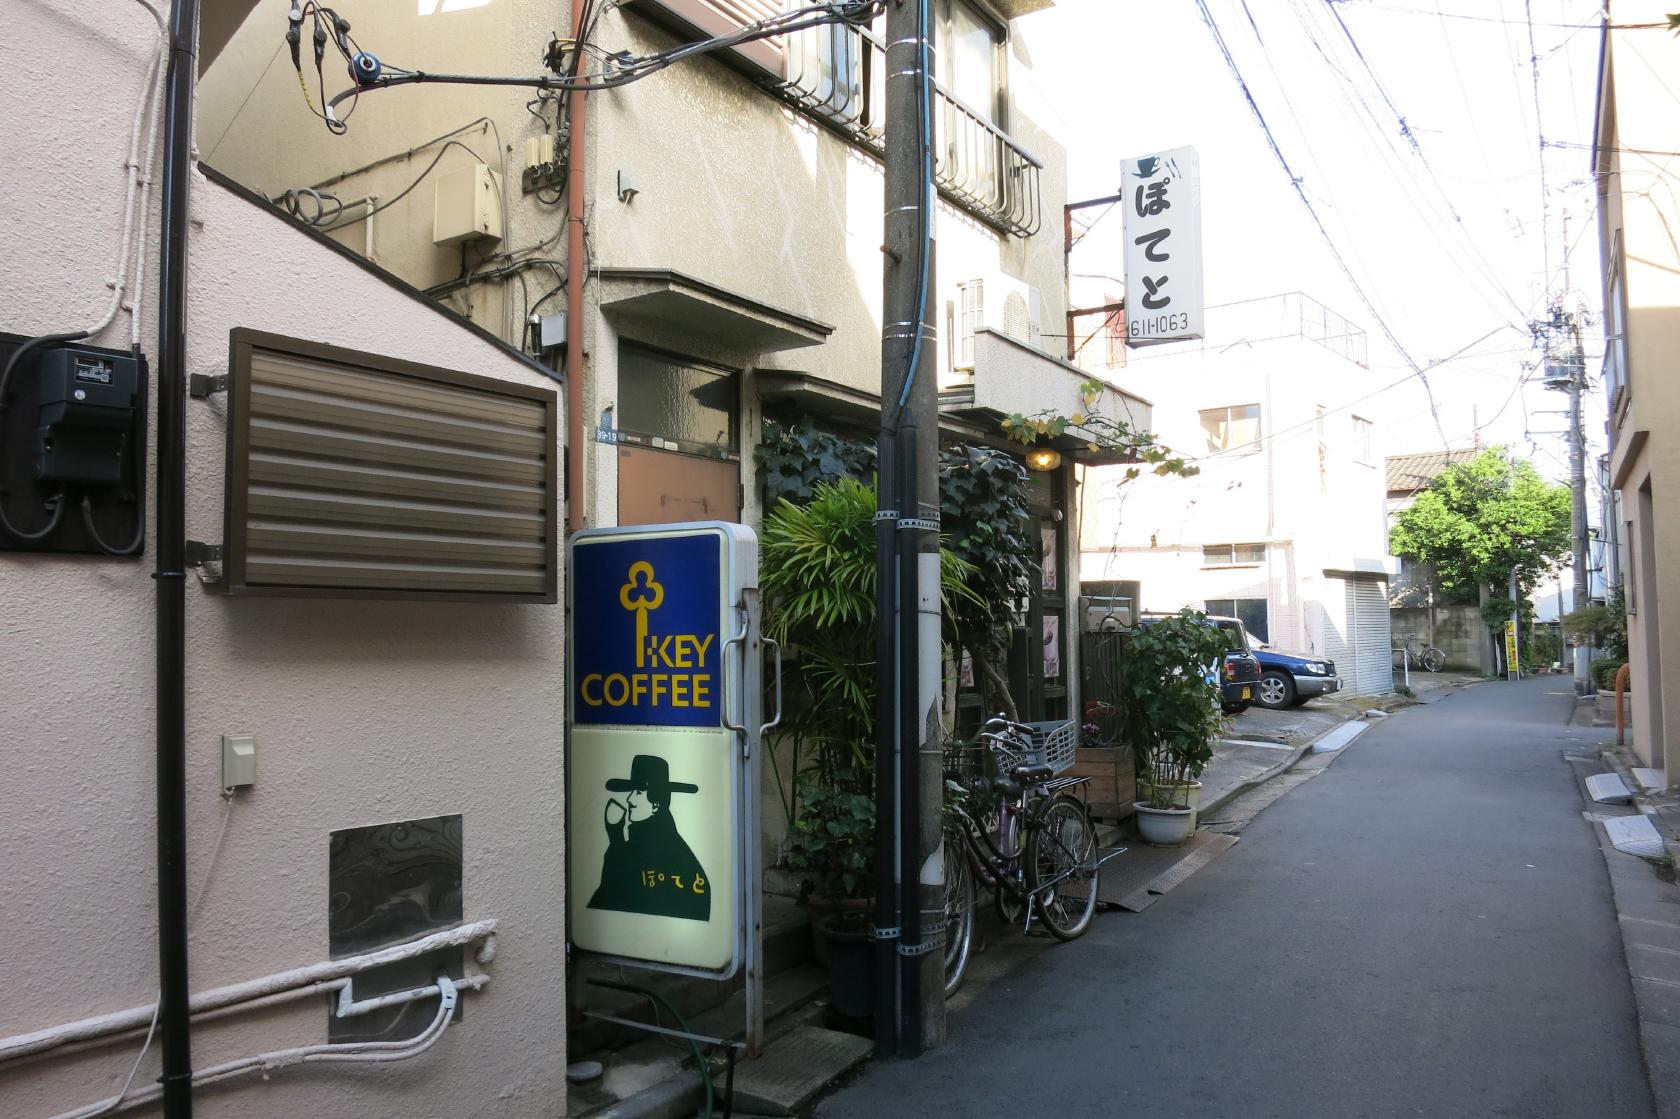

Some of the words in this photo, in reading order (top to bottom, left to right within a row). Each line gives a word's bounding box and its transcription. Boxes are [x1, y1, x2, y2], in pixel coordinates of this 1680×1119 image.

[1135, 177, 1171, 309] ぽてと
[1131, 312, 1188, 337] 611-1063
[646, 633, 715, 668] KEY
[580, 672, 711, 708] COFFEE
[642, 870, 705, 894] ぽてと
